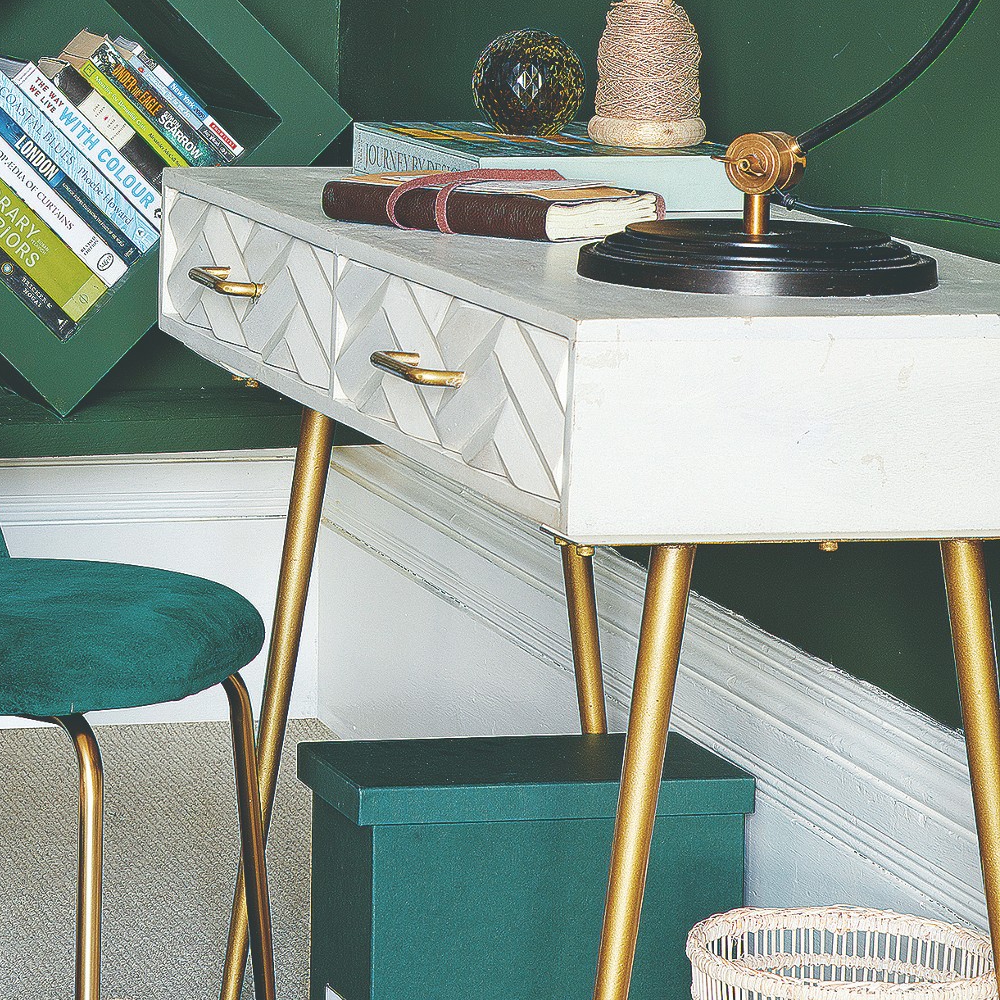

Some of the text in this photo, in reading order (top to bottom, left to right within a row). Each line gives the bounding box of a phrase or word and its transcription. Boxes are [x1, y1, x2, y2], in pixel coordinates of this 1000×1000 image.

[28, 83, 57, 114] WE LIVE
[33, 76, 64, 107] THE WAY
[169, 82, 196, 109] New York
[162, 109, 181, 128] SIMON
[42, 131, 76, 166] BLUES
[156, 113, 203, 160] SCARROW
[13, 134, 59, 181] LONDON
[57, 106, 156, 209] WITH COLOUR
[364, 143, 410, 172] JOURNEY
